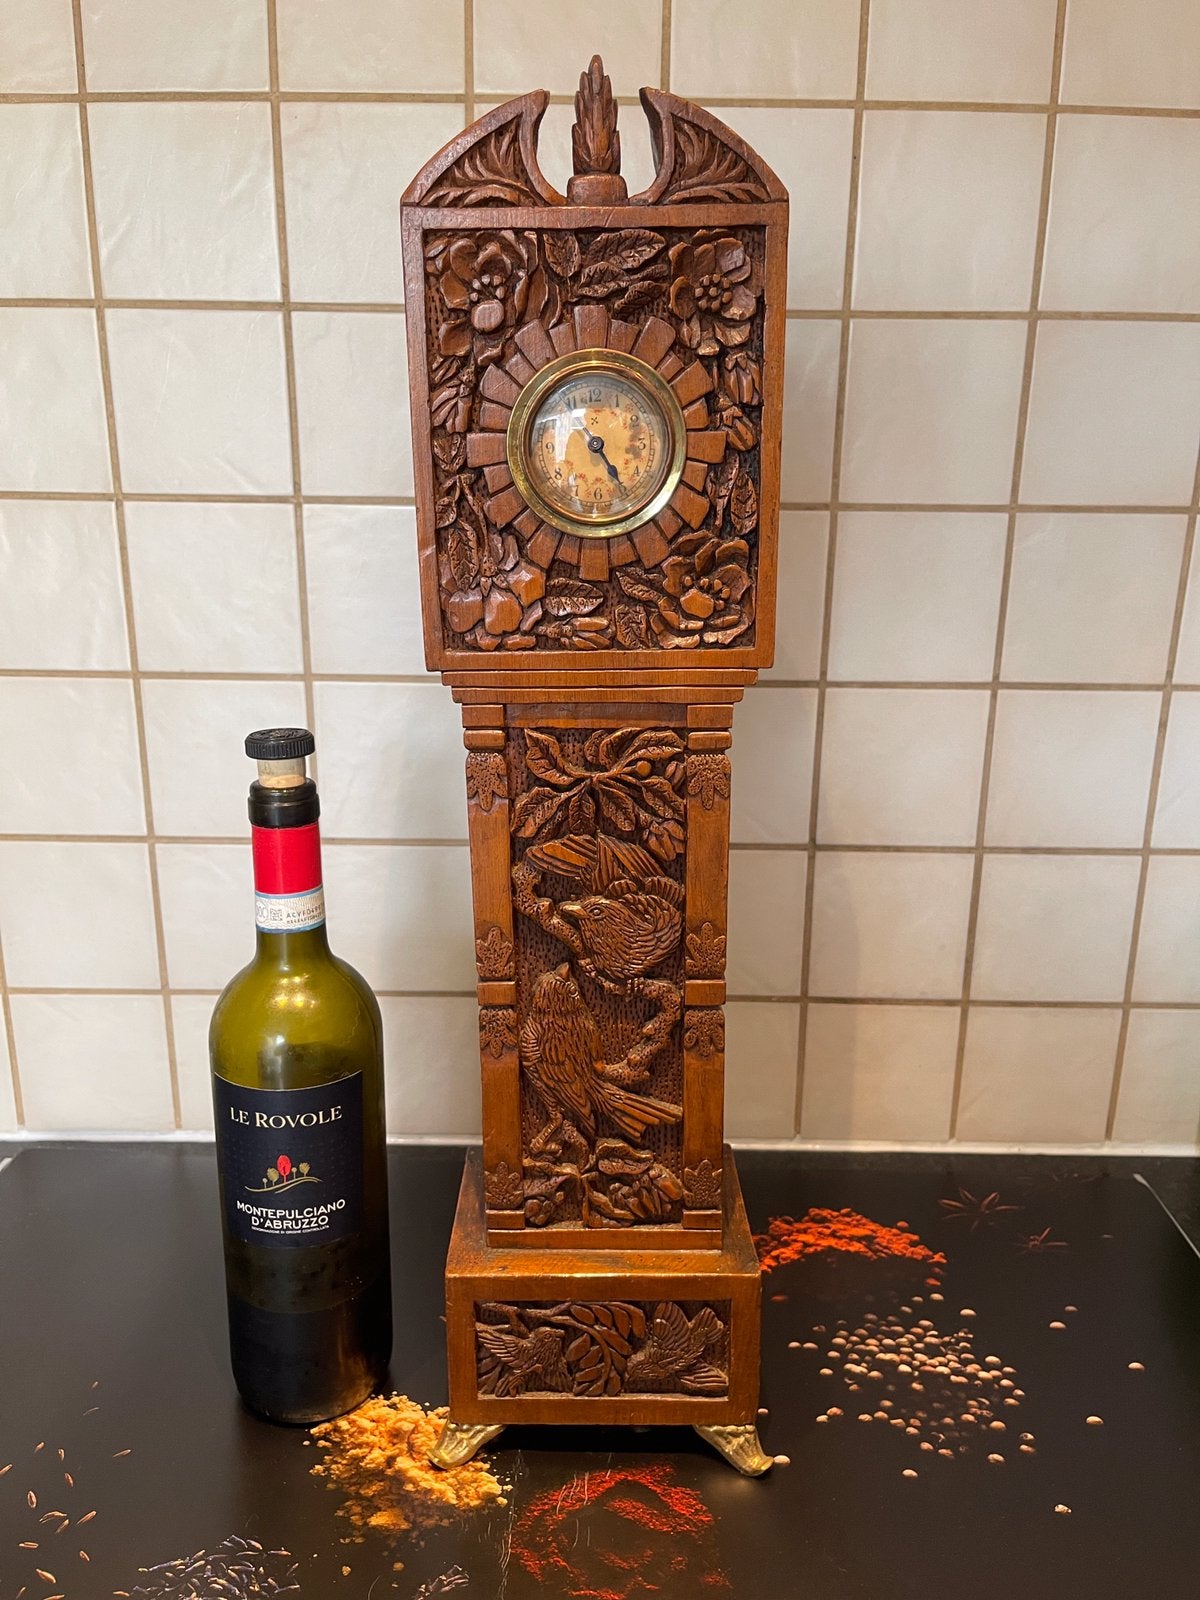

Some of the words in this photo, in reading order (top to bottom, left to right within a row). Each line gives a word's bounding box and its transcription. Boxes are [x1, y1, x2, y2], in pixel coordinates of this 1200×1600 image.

[587, 387, 602, 403] 12
[615, 394, 620, 408] 1
[630, 414, 640, 428] 2
[545, 442, 555, 455] 9
[637, 437, 646, 450] 3
[555, 467, 563, 480] 8
[633, 465, 641, 476] 4
[593, 487, 603, 500] 6
[230, 1106, 250, 1125] LE
[255, 1105, 343, 1129] ROVOLE
[236, 1198, 346, 1219] MONTEPULCIANO
[251, 1215, 329, 1230] D'ABRUZZO
